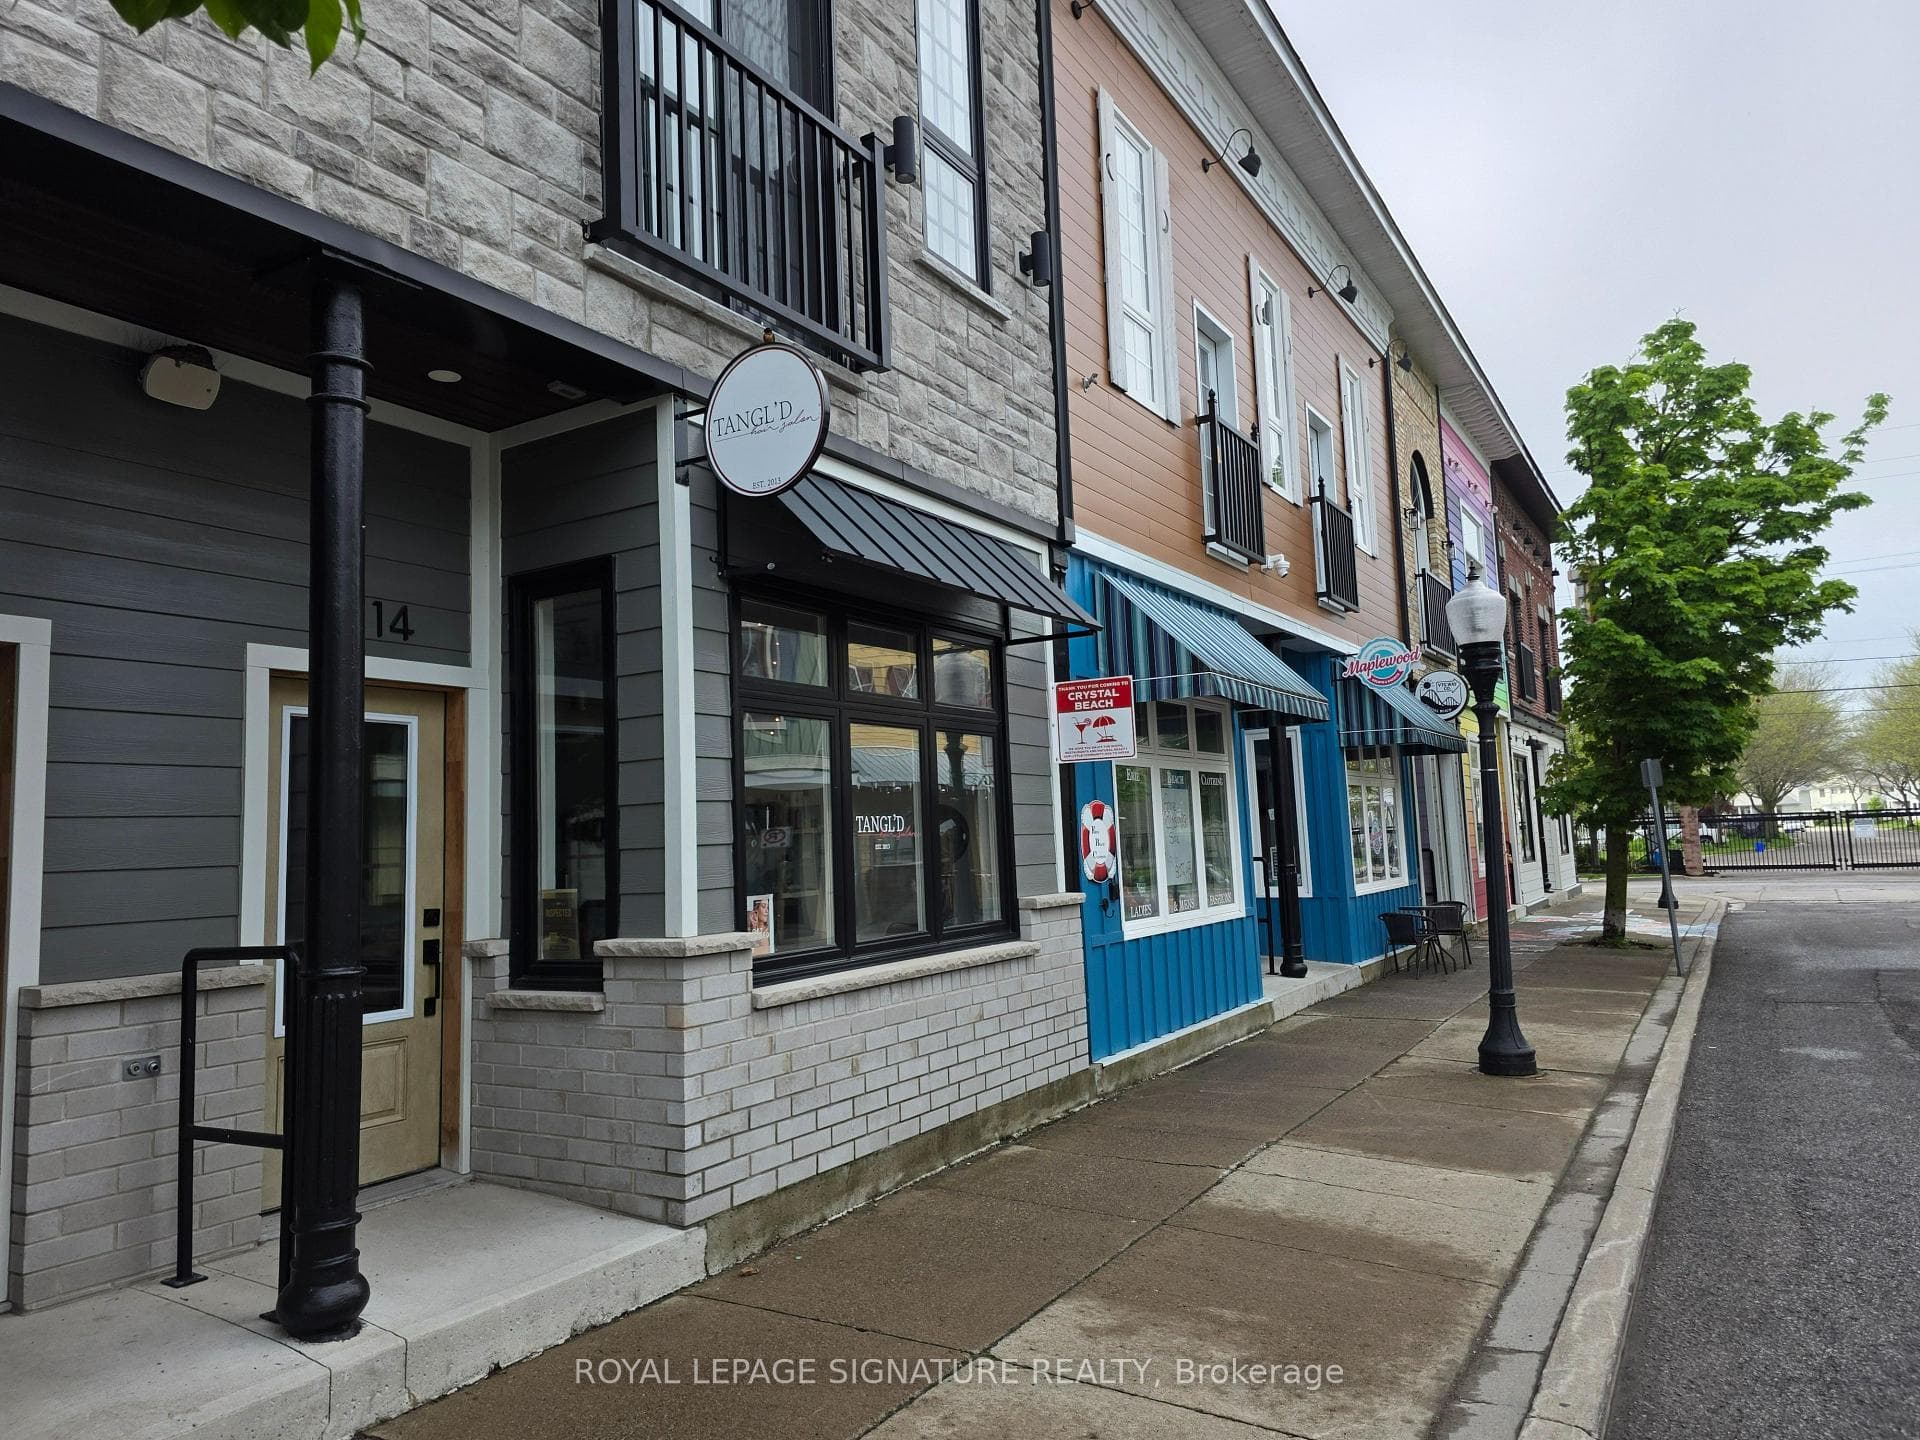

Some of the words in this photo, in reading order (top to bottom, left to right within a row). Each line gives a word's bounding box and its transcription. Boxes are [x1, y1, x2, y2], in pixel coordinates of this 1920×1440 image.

[713, 400, 793, 437] TANGL'D
[779, 409, 818, 433] salon
[371, 600, 415, 641] 14
[1343, 645, 1420, 676] Maplewood
[1067, 688, 1120, 701] CRYSTAL
[1074, 699, 1114, 710] BEACH
[855, 814, 905, 833] TANGL'D
